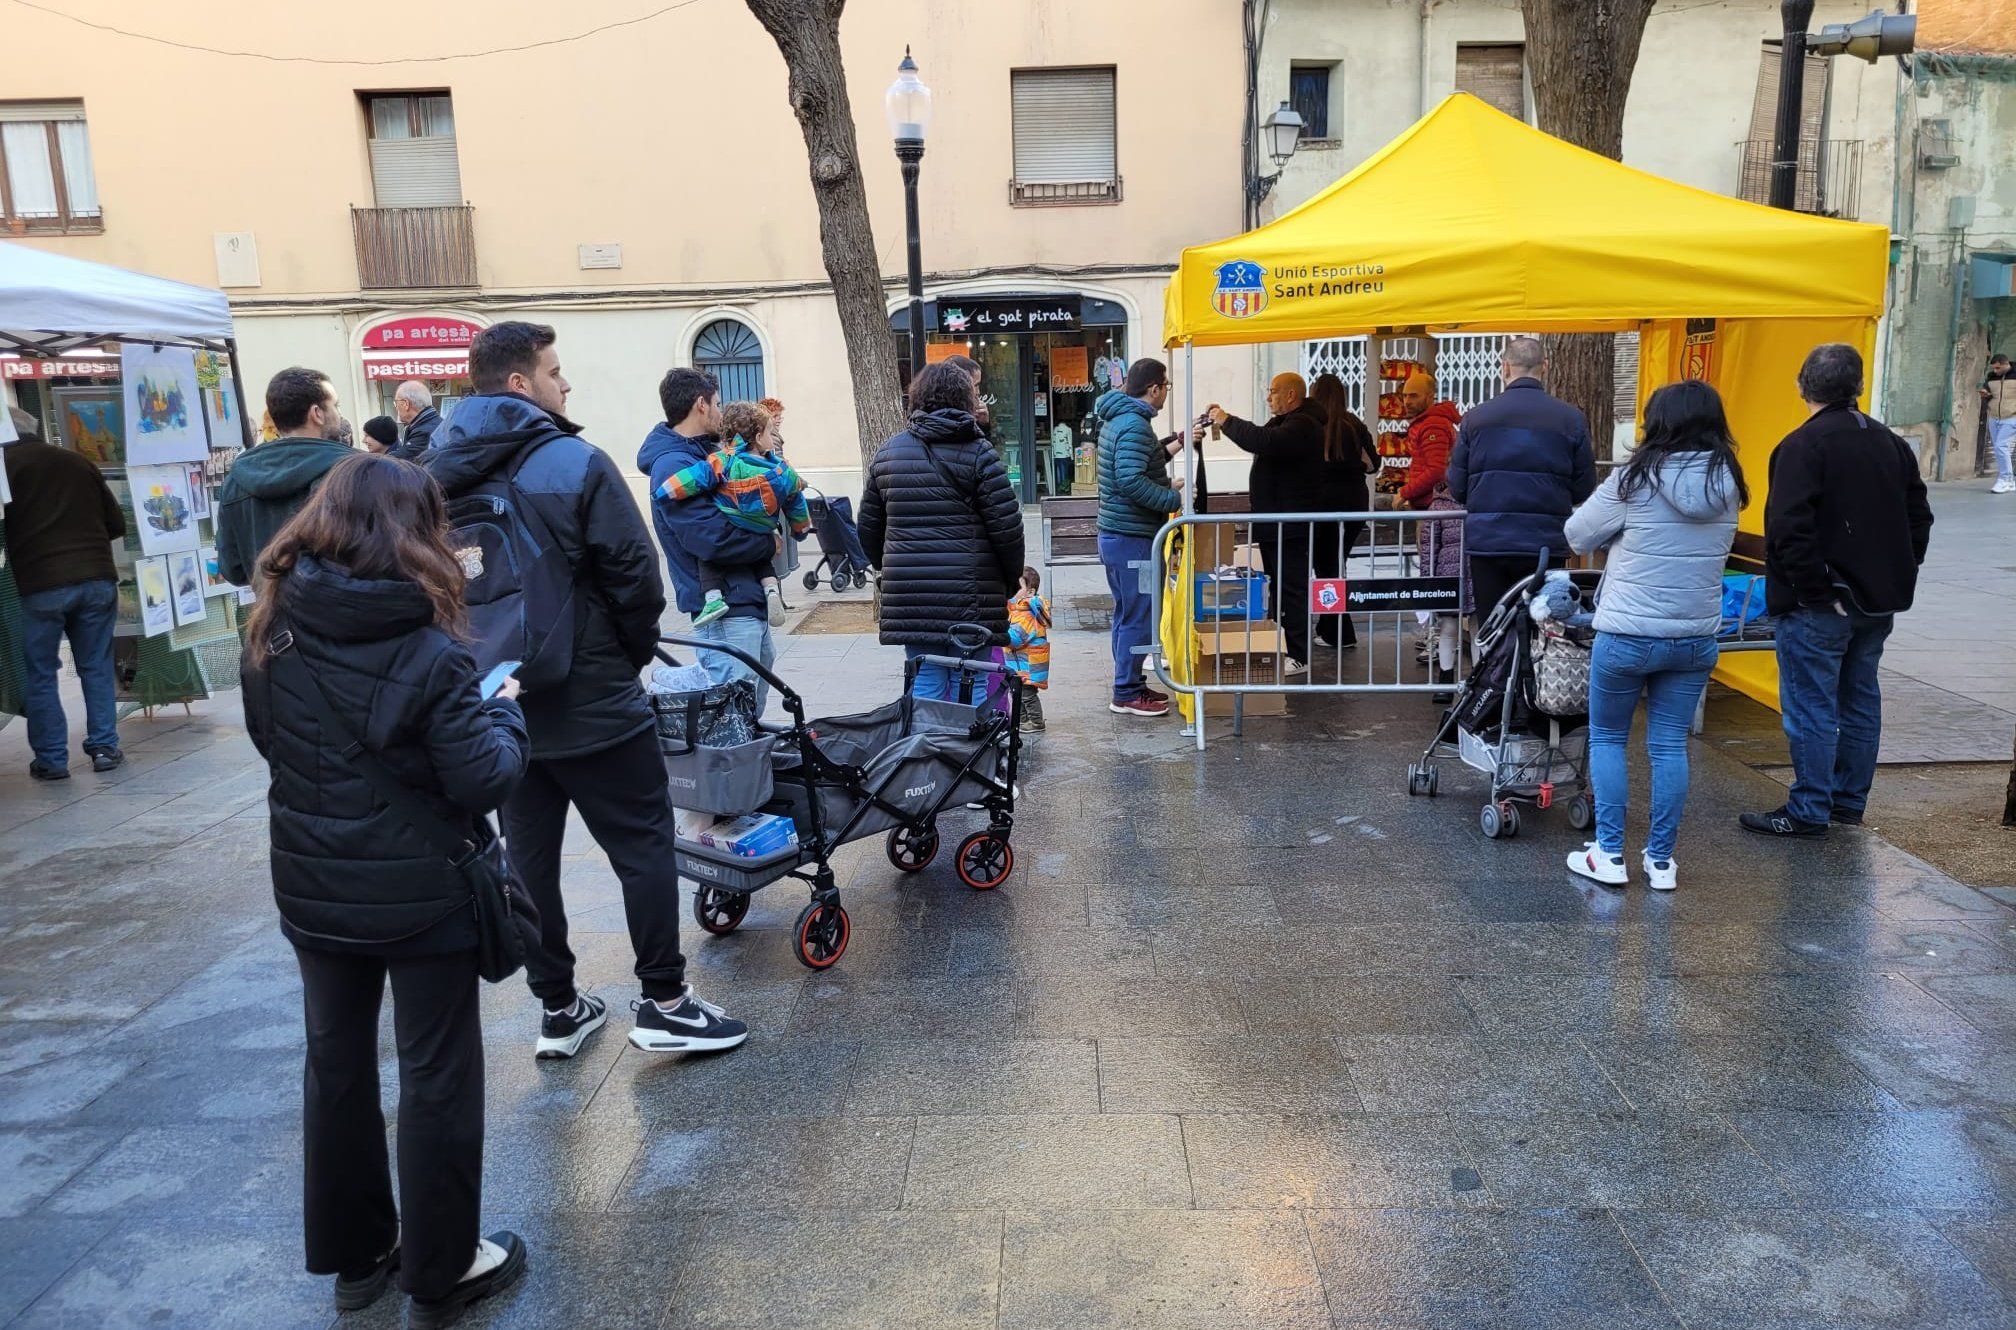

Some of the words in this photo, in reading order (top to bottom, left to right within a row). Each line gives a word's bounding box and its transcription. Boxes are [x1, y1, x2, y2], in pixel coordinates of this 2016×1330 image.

[1274, 265, 1307, 279] Unió
[1312, 264, 1384, 279] Esportiva
[1274, 283, 1314, 298] Sant
[1320, 281, 1384, 296] Andreu
[976, 310, 992, 323] el
[998, 309, 1022, 327] gat
[1028, 307, 1073, 329] pirata
[382, 328, 404, 342] pa
[410, 325, 469, 338] artesà
[3, 362, 34, 378] pa
[367, 361, 469, 379] pastisseri
[1400, 590, 1411, 599] de
[1414, 589, 1456, 599] Barcelona
